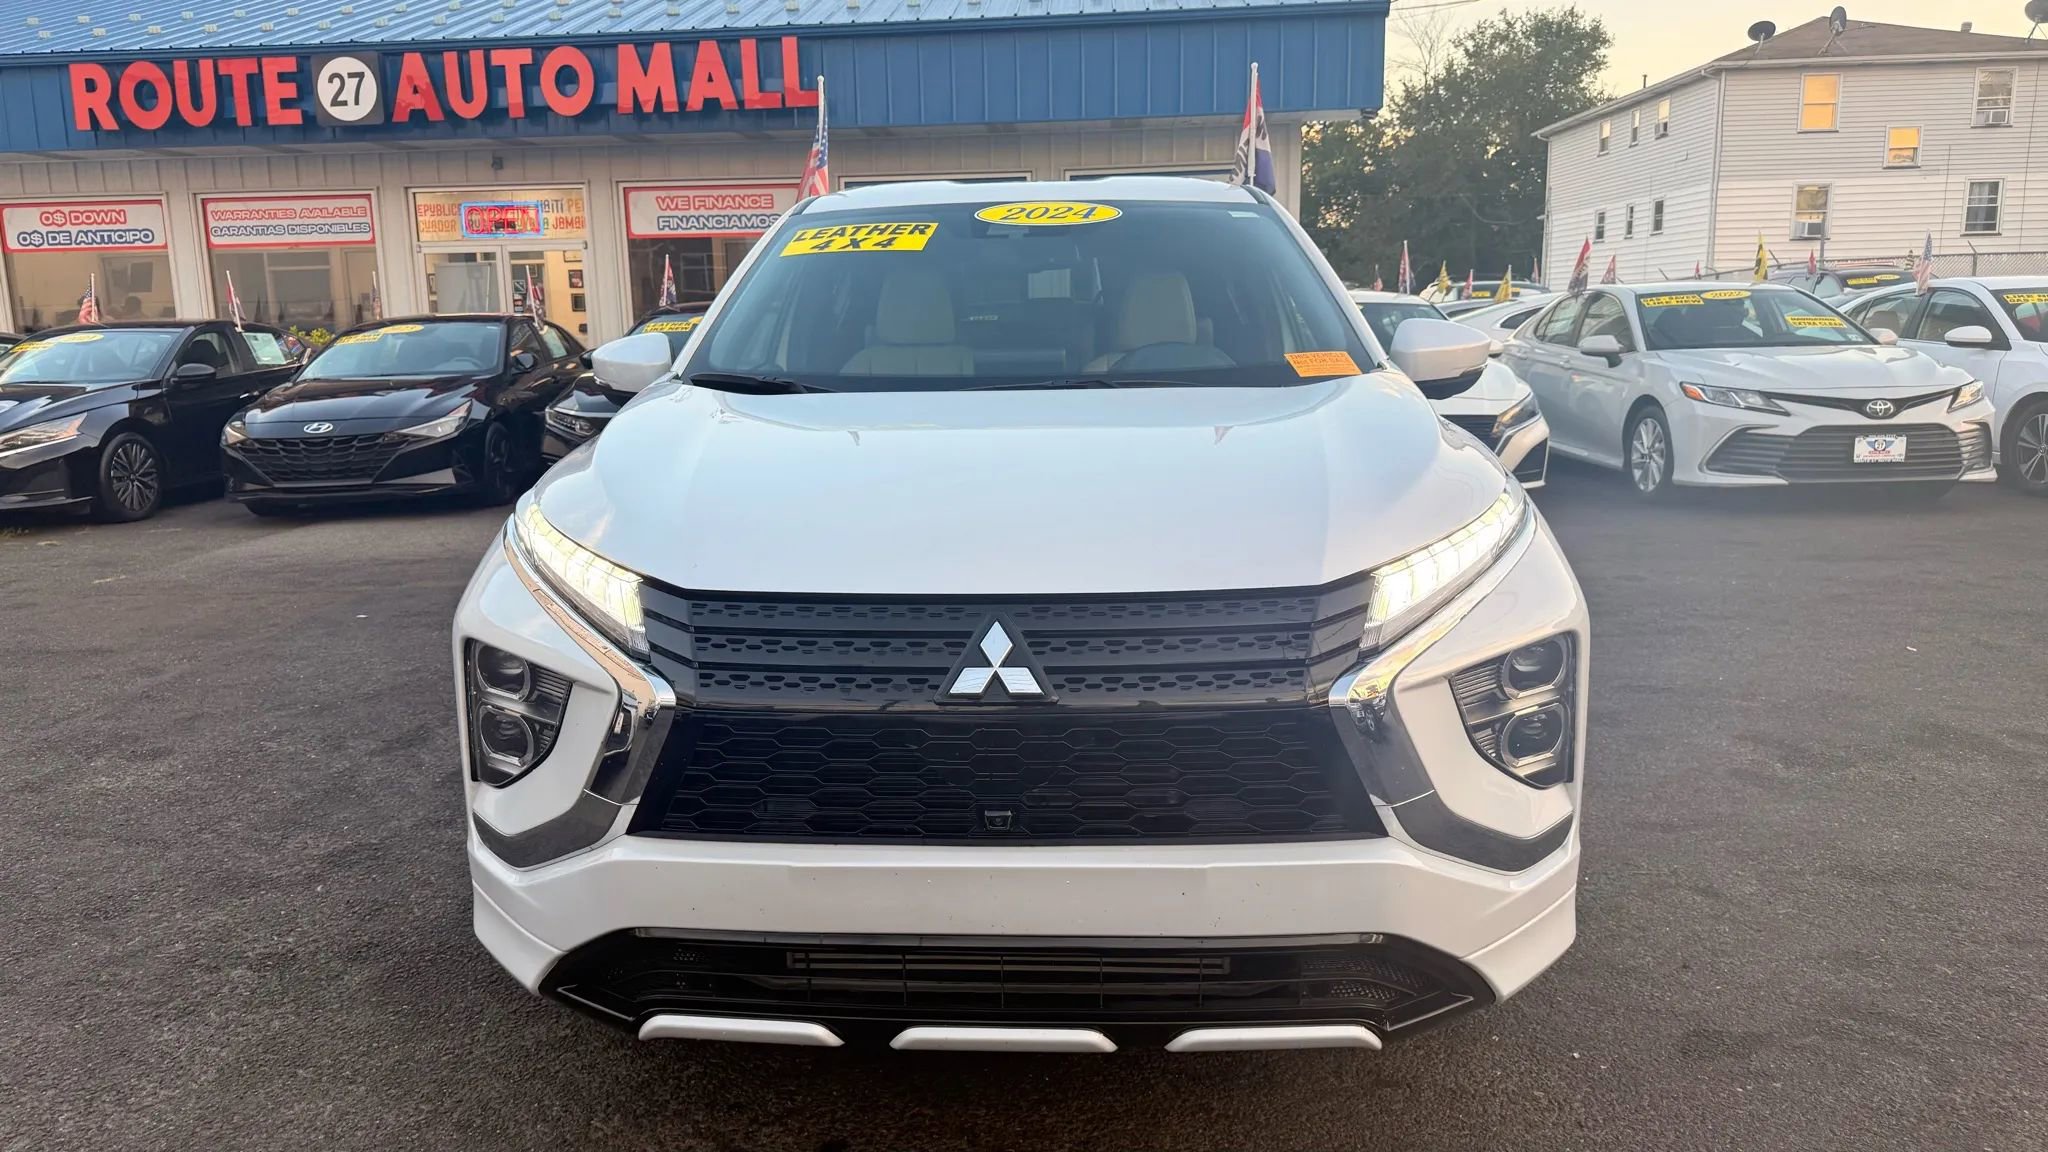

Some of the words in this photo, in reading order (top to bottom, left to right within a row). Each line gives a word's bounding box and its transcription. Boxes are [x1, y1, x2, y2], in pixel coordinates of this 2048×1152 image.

[68, 56, 303, 131] ROUTE
[327, 71, 365, 108] 27
[392, 46, 595, 123] AUTO
[617, 36, 819, 115] MALL
[656, 195, 690, 210] WE
[693, 194, 774, 209] FINANCE
[68, 208, 127, 225] DOWN
[210, 208, 297, 221] WARRANTIES
[299, 206, 368, 219] AVAILABLE
[464, 206, 541, 234] OPEN
[657, 213, 782, 231] FINANCIAMOS
[999, 206, 1097, 221] 2024
[46, 230, 73, 246] DE
[74, 227, 155, 245] ANTICIPO
[210, 225, 286, 238] GARANTIAS
[287, 222, 370, 235] DISPONIBLES
[793, 223, 931, 242] LEATHER
